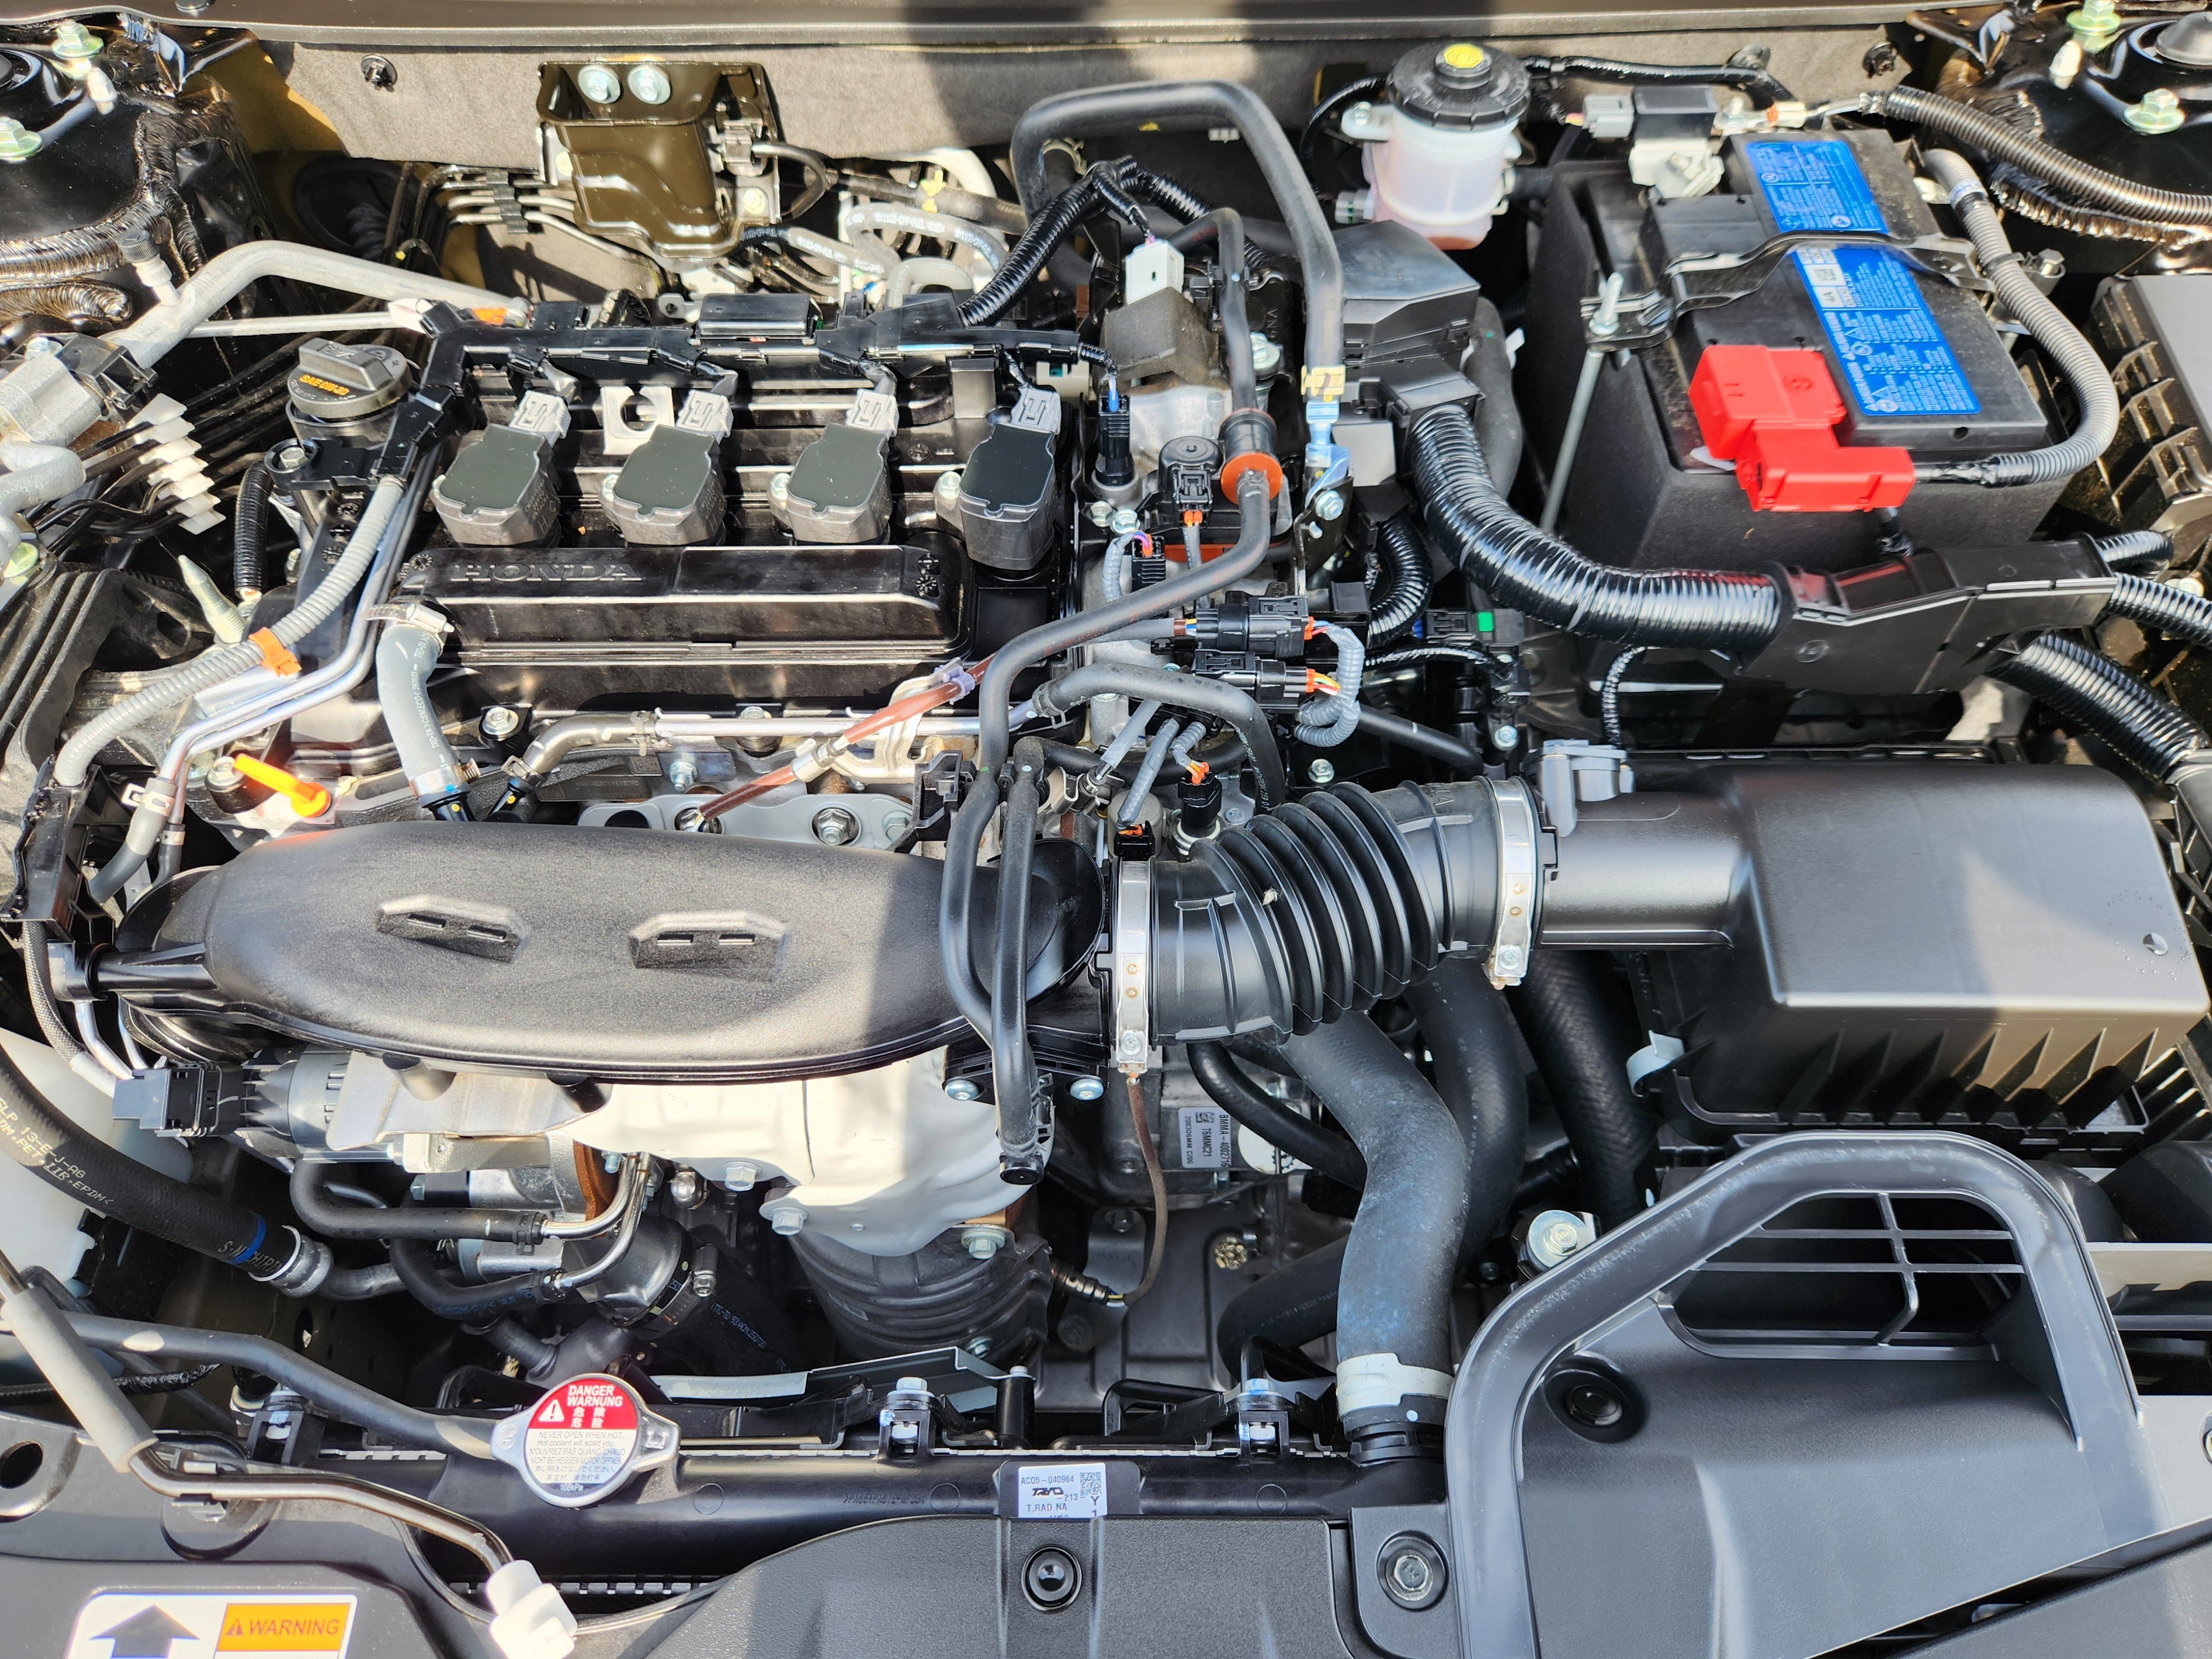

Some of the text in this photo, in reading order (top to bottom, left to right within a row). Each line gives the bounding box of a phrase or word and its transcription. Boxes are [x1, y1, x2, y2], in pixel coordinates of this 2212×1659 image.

[450, 564, 642, 581] HONDA
[1202, 1128, 1212, 1156] T6MMC21
[568, 1385, 614, 1396] DANGER
[567, 1396, 623, 1407] WARNUNG
[1091, 1495, 1099, 1506] Y
[1027, 1504, 1052, 1512] T.RAD
[249, 1619, 340, 1635] WARNING
